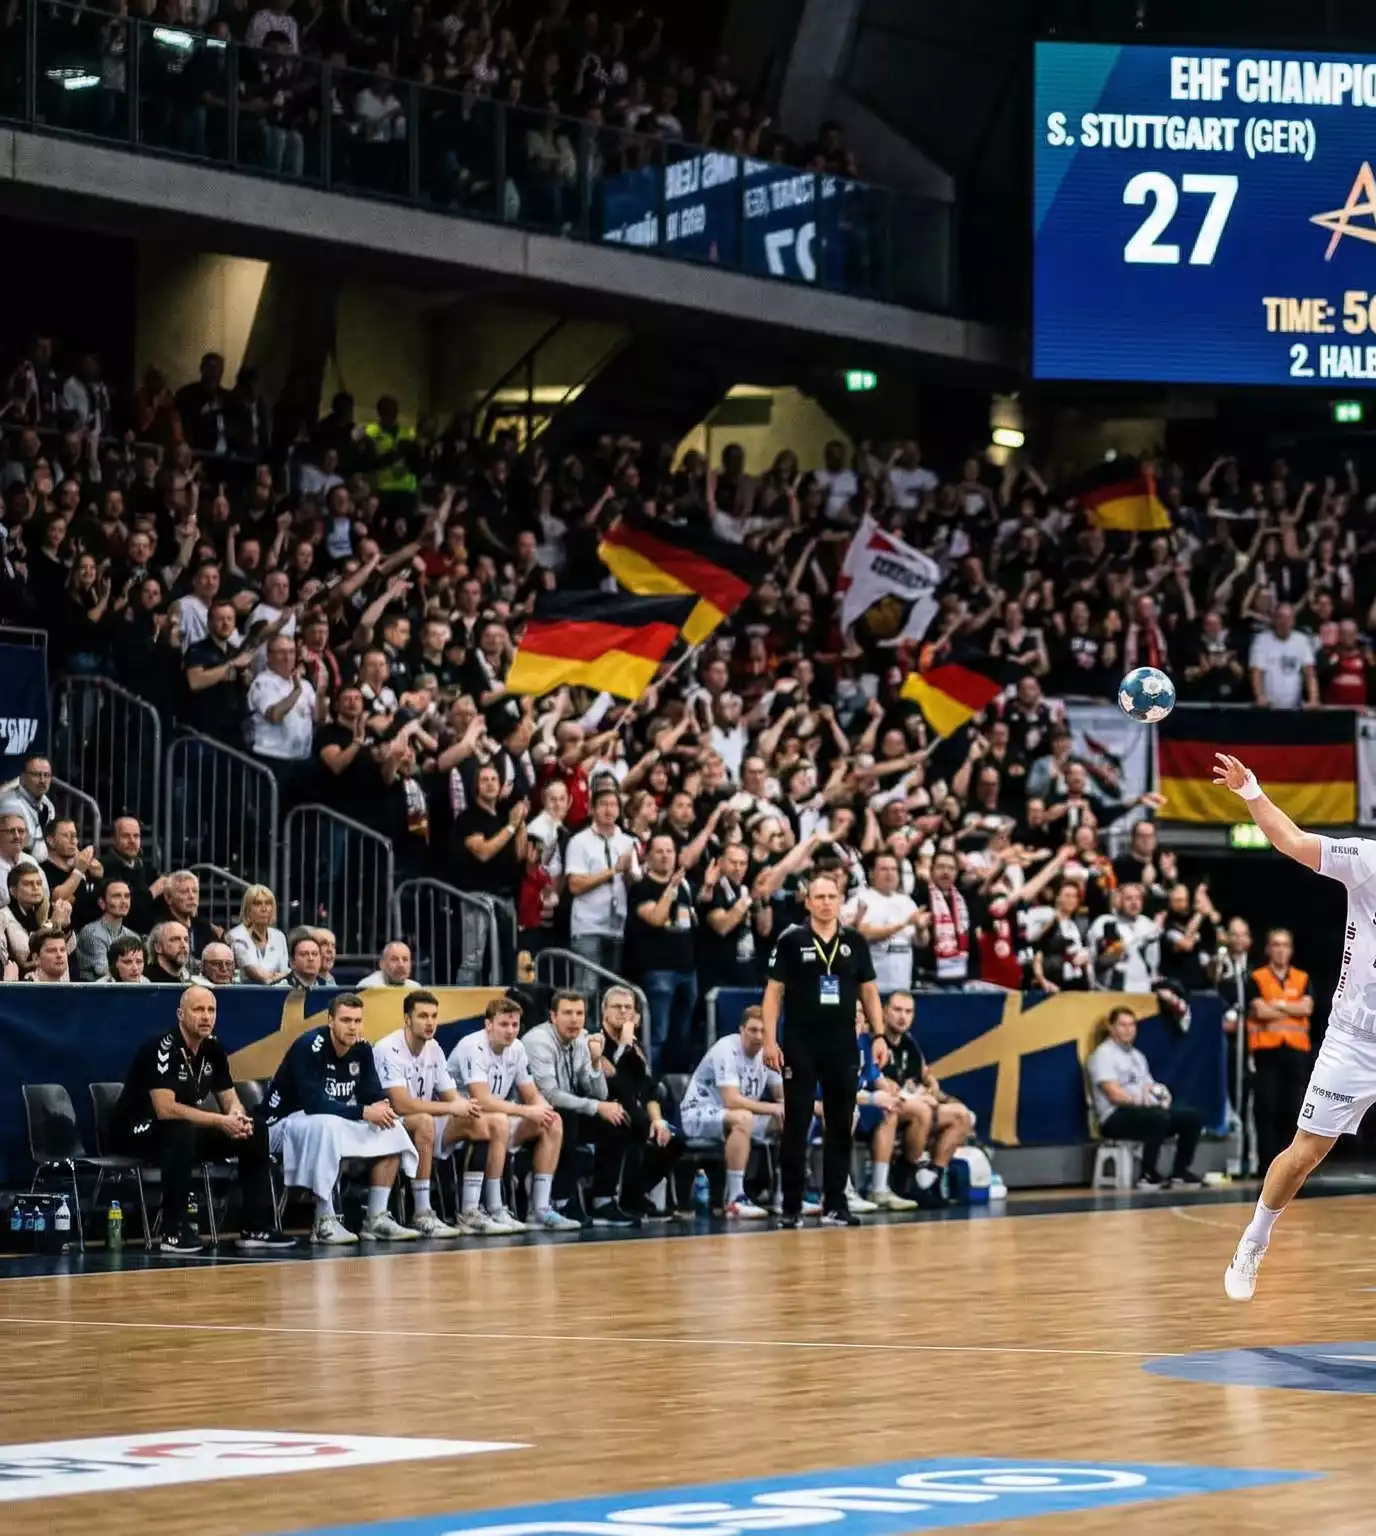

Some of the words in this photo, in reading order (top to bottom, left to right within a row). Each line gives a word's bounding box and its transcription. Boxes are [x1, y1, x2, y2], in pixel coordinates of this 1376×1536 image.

[1170, 57, 1230, 102] EHF
[1047, 113, 1075, 146] S.
[1081, 114, 1239, 152] STUTTGART
[1244, 118, 1316, 161] (GER)
[1122, 171, 1239, 265] 27
[1262, 296, 1336, 334] TIME:
[1289, 346, 1314, 379] 2.
